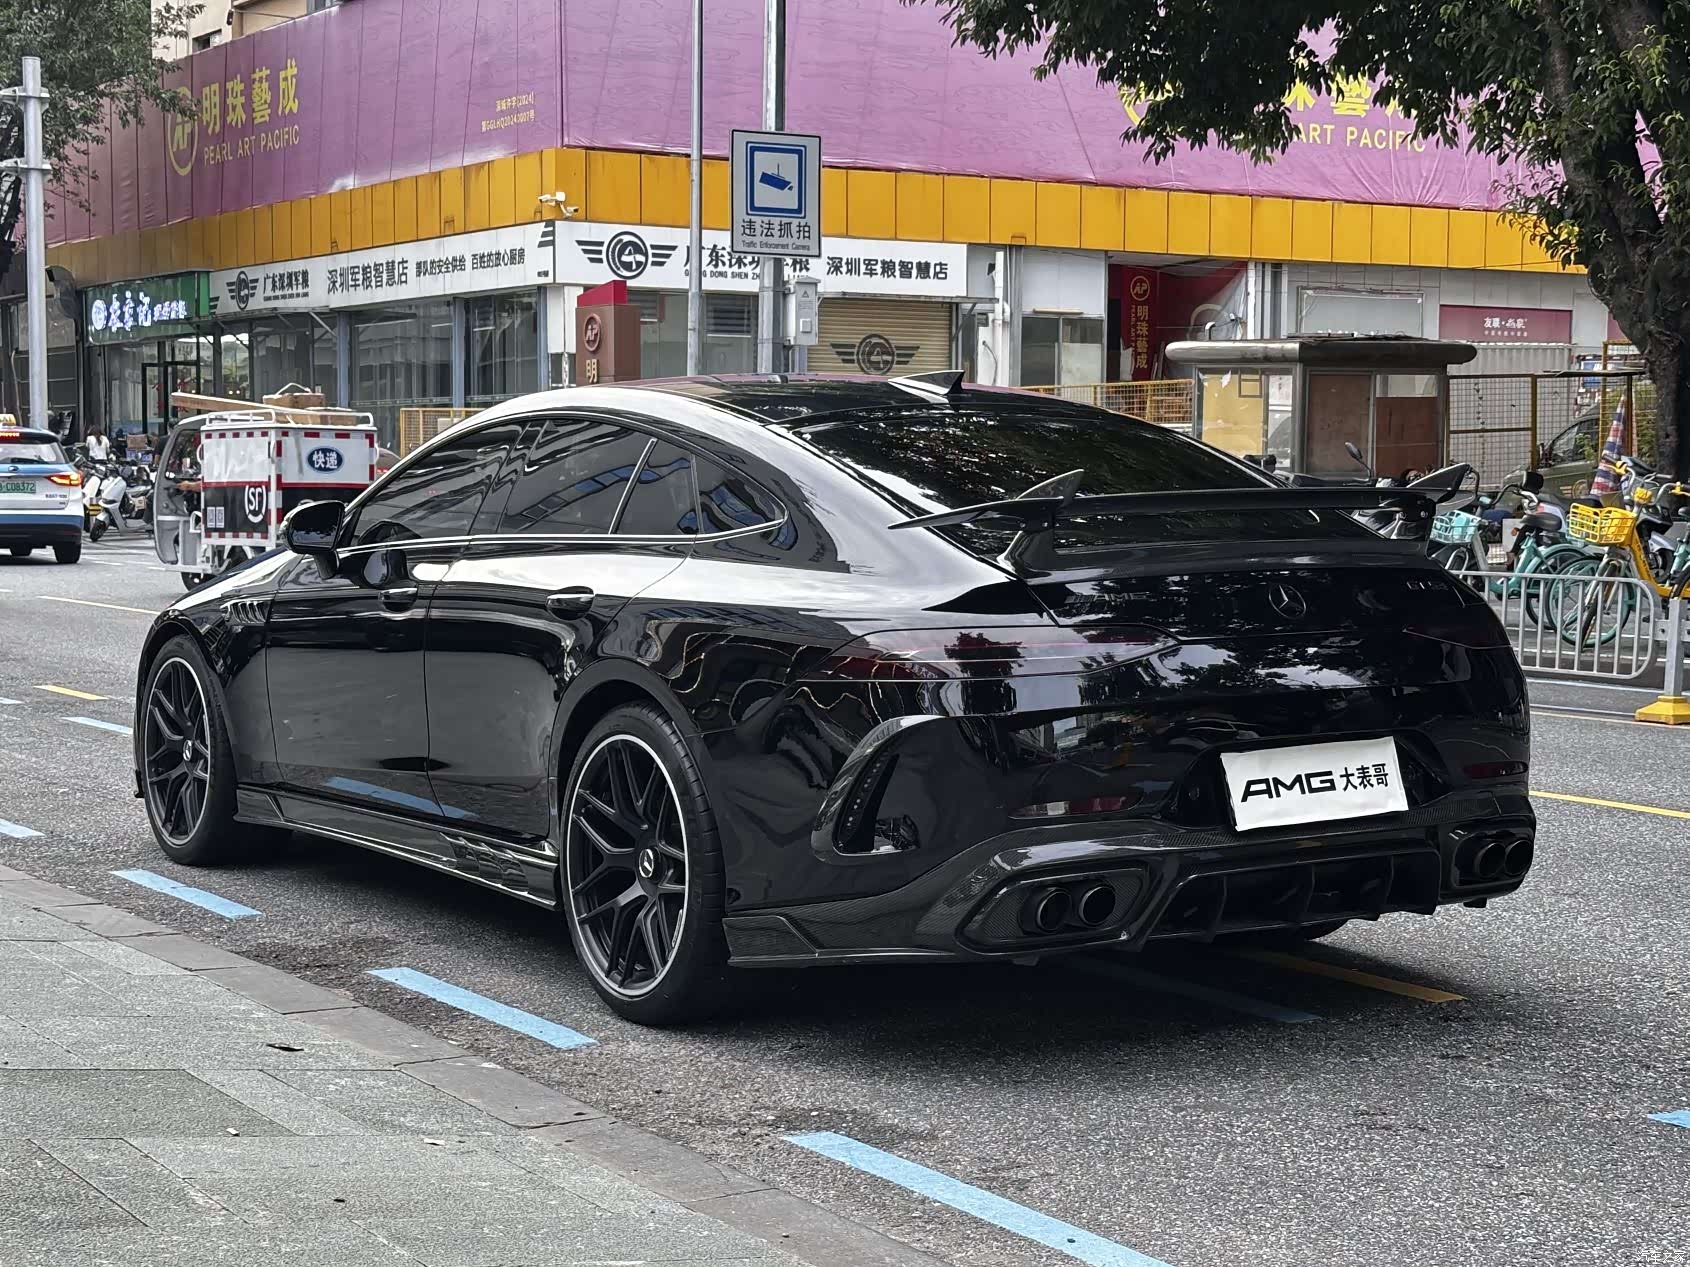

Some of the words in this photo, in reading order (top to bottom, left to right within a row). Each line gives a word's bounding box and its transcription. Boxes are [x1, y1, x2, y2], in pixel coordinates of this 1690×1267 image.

[202, 57, 299, 136] 明珠藝成
[204, 141, 233, 166] PEARL
[238, 136, 256, 159] ART
[260, 124, 300, 153] PACIFIC
[1346, 126, 1427, 152] PACIFIC
[741, 218, 811, 241] 违法抓拍
[327, 257, 408, 295] 深圳军粮智慧店
[415, 255, 466, 278] 部队的安全供给
[471, 247, 526, 270] 百姓的放心厨房
[710, 270, 728, 279] DONG
[730, 272, 749, 280] SHEN
[826, 256, 948, 281] 深圳军粮智慧店
[263, 268, 310, 295] 广东深圳军粮
[1136, 305, 1149, 369] 明珠藝成
[586, 359, 597, 383] 明
[313, 450, 338, 469] 快递
[1241, 770, 1337, 802] AMG
[1340, 763, 1389, 792] 大表哥
